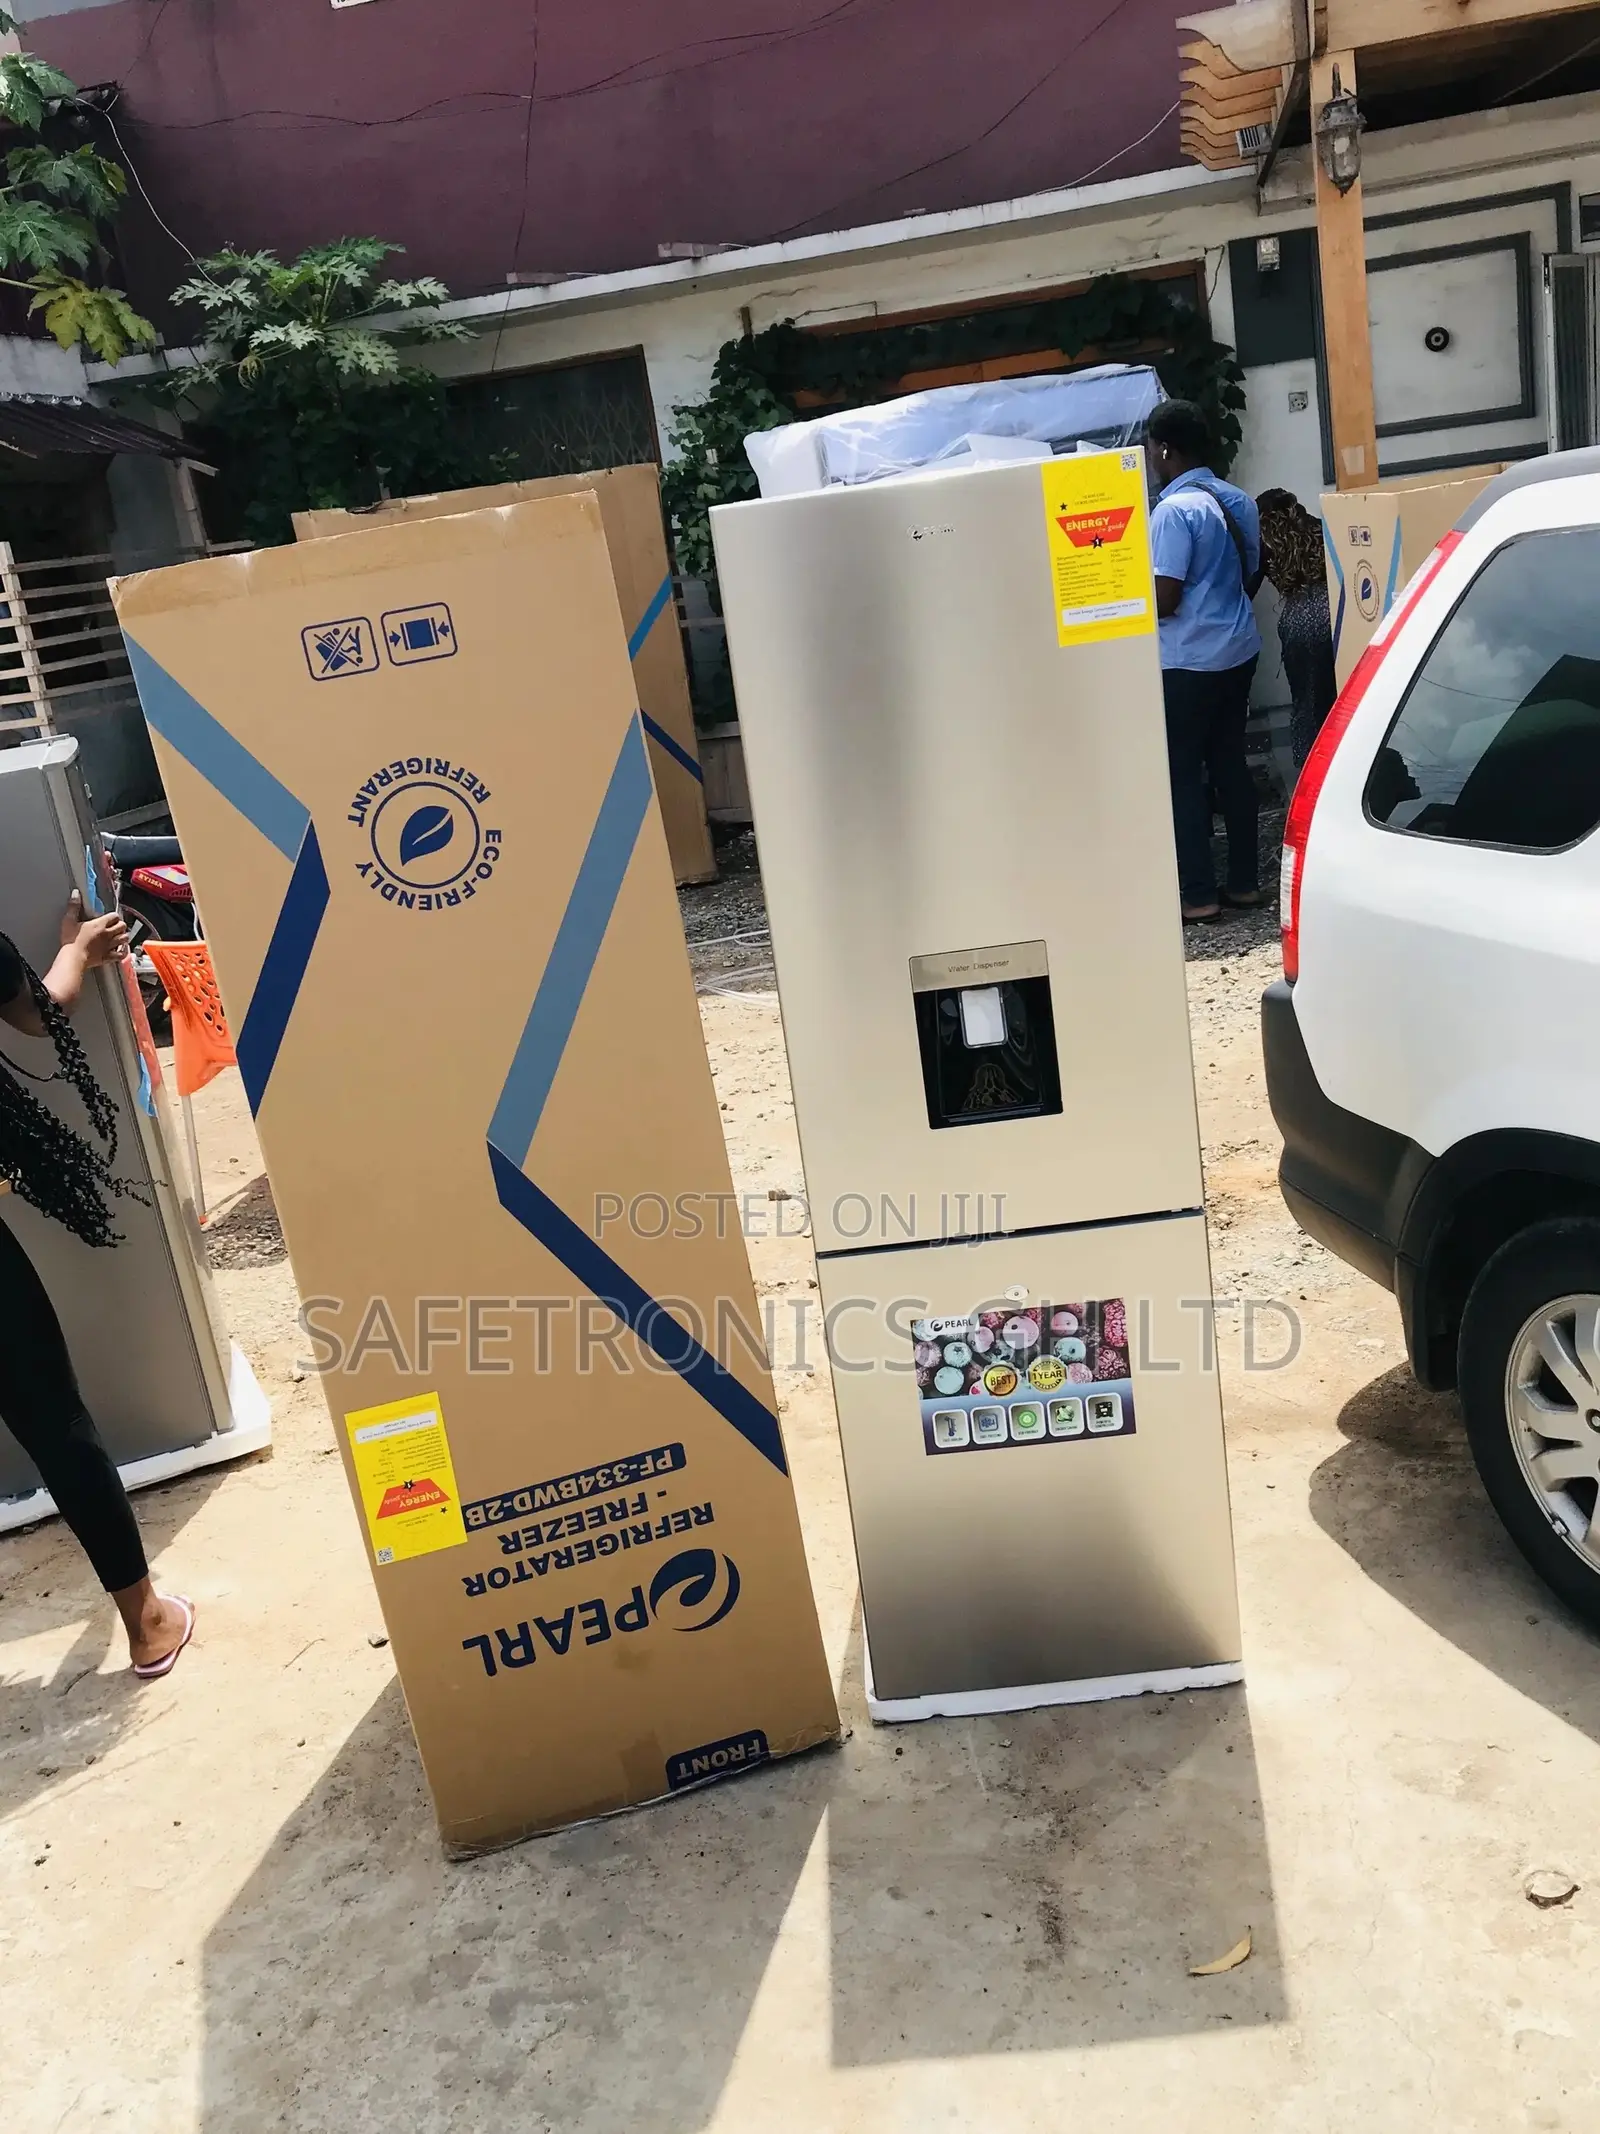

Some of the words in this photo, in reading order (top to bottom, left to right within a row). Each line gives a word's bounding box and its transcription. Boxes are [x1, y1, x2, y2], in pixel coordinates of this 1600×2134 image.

[1065, 516, 1111, 532] ENERGY
[347, 757, 492, 828] REFRIGERANT
[355, 830, 502, 911] ECO-FRIENDLY
[948, 964, 970, 973] Water
[973, 959, 1010, 970] Dispenser
[944, 1319, 974, 1329] PEARL
[990, 1374, 1012, 1386] BEST
[1038, 1370, 1063, 1380] YEAR
[399, 1490, 441, 1508] ENERGY
[465, 1449, 674, 1527] PF-334BWD-2B
[497, 1491, 649, 1555] FREEZER
[461, 1501, 715, 1598] REFRIGERATOR
[461, 1585, 650, 1677] PEARL
[676, 1738, 761, 1780] FRONT
